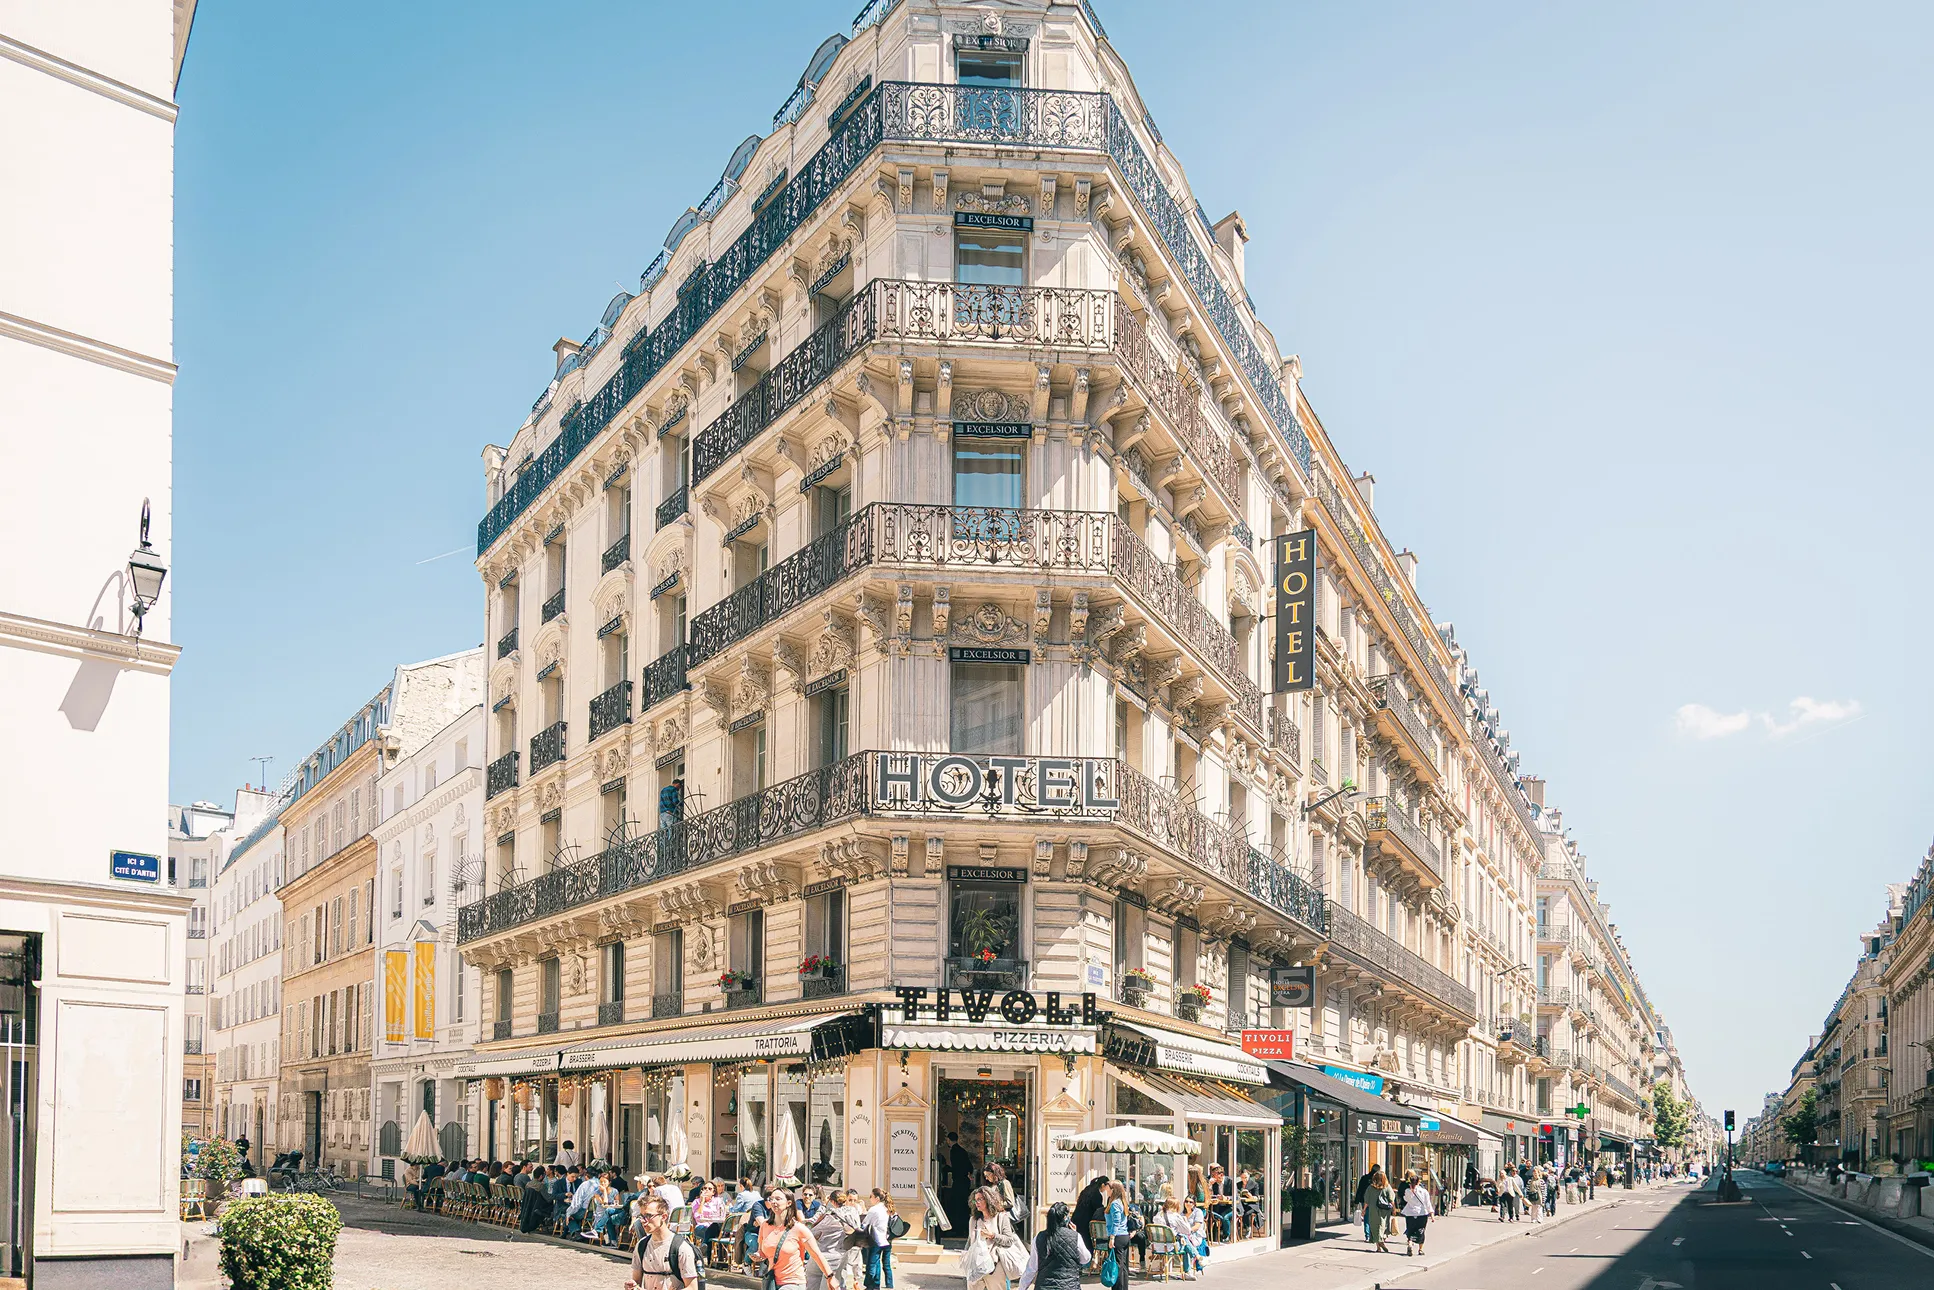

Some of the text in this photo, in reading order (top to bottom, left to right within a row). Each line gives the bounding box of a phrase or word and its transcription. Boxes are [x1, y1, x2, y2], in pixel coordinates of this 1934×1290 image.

[968, 215, 1020, 227] EXCELSIOR
[966, 424, 1018, 434] EXCELSIOR
[1282, 538, 1308, 684] HOTEL
[963, 650, 1016, 660] EXCELSIOR
[878, 752, 1120, 811] HOTEL
[127, 857, 137, 865] ICI
[131, 868, 156, 878] D'ANTIN
[961, 869, 1013, 879] EXCELSIOR
[1273, 983, 1311, 991] EXCELSIOR
[896, 986, 1096, 1026] TIVOLI
[755, 1036, 798, 1050] TRATTORIA
[993, 1031, 1067, 1046] PIZZERIA
[1244, 1034, 1290, 1042] TIVOLI
[1252, 1047, 1283, 1055] PIZZA
[569, 1053, 596, 1064] BRASSERIE
[1165, 1049, 1193, 1064] BRASSERIE
[532, 1058, 552, 1067] PIZZERIA
[1357, 1119, 1363, 1134] 5
